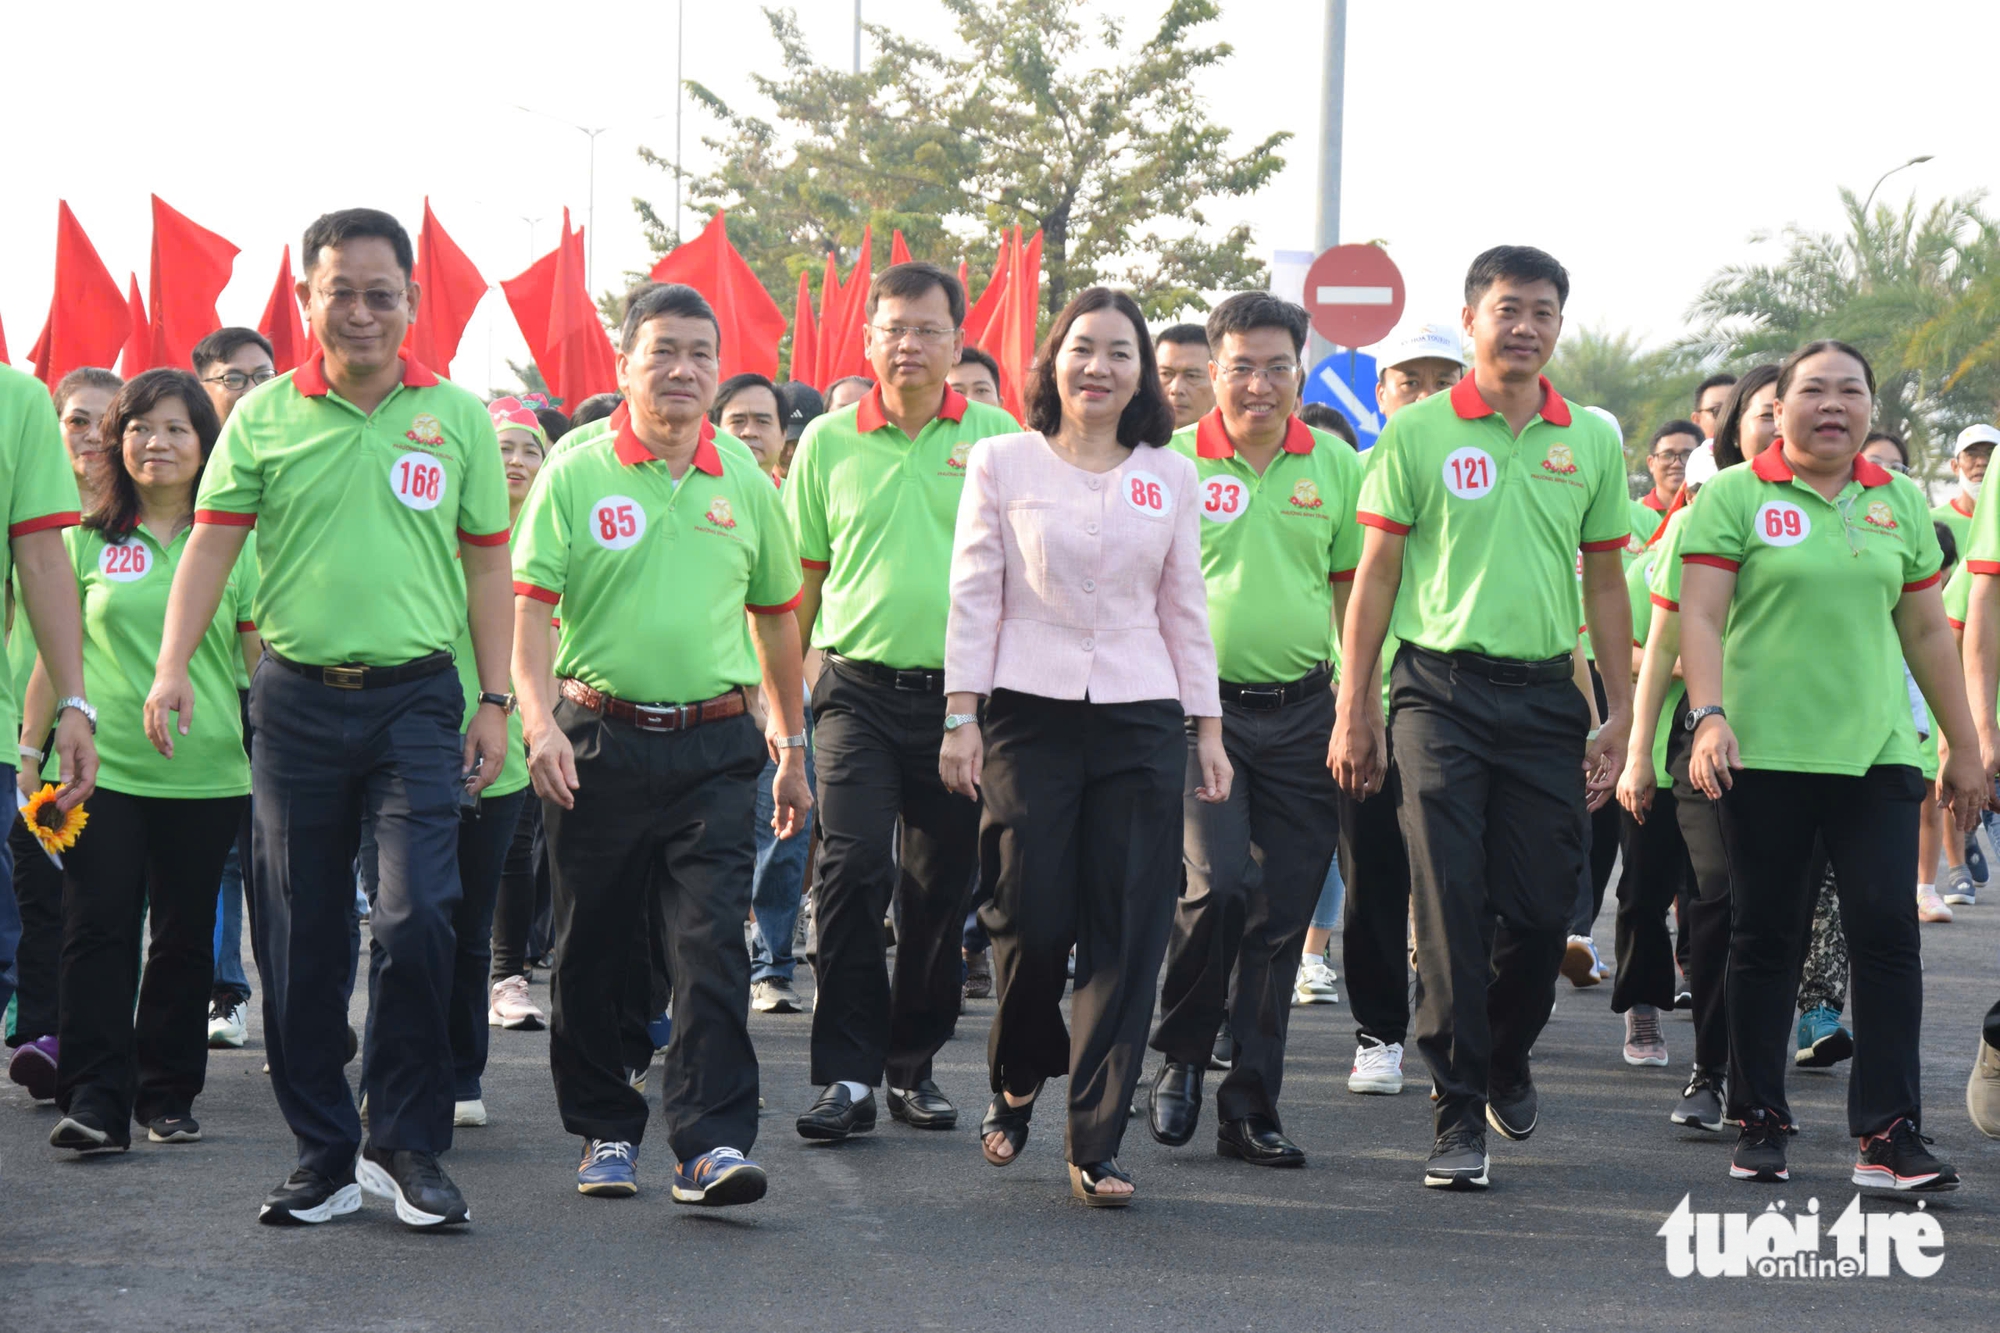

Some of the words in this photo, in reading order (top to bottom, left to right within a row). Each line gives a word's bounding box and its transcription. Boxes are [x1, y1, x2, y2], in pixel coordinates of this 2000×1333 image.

[401, 461, 440, 501] 168
[1451, 456, 1489, 490] 121
[1131, 478, 1163, 510] 86
[1205, 482, 1240, 513] 33
[598, 505, 636, 540] 85
[1765, 508, 1801, 537] 69
[106, 545, 145, 574] 226
